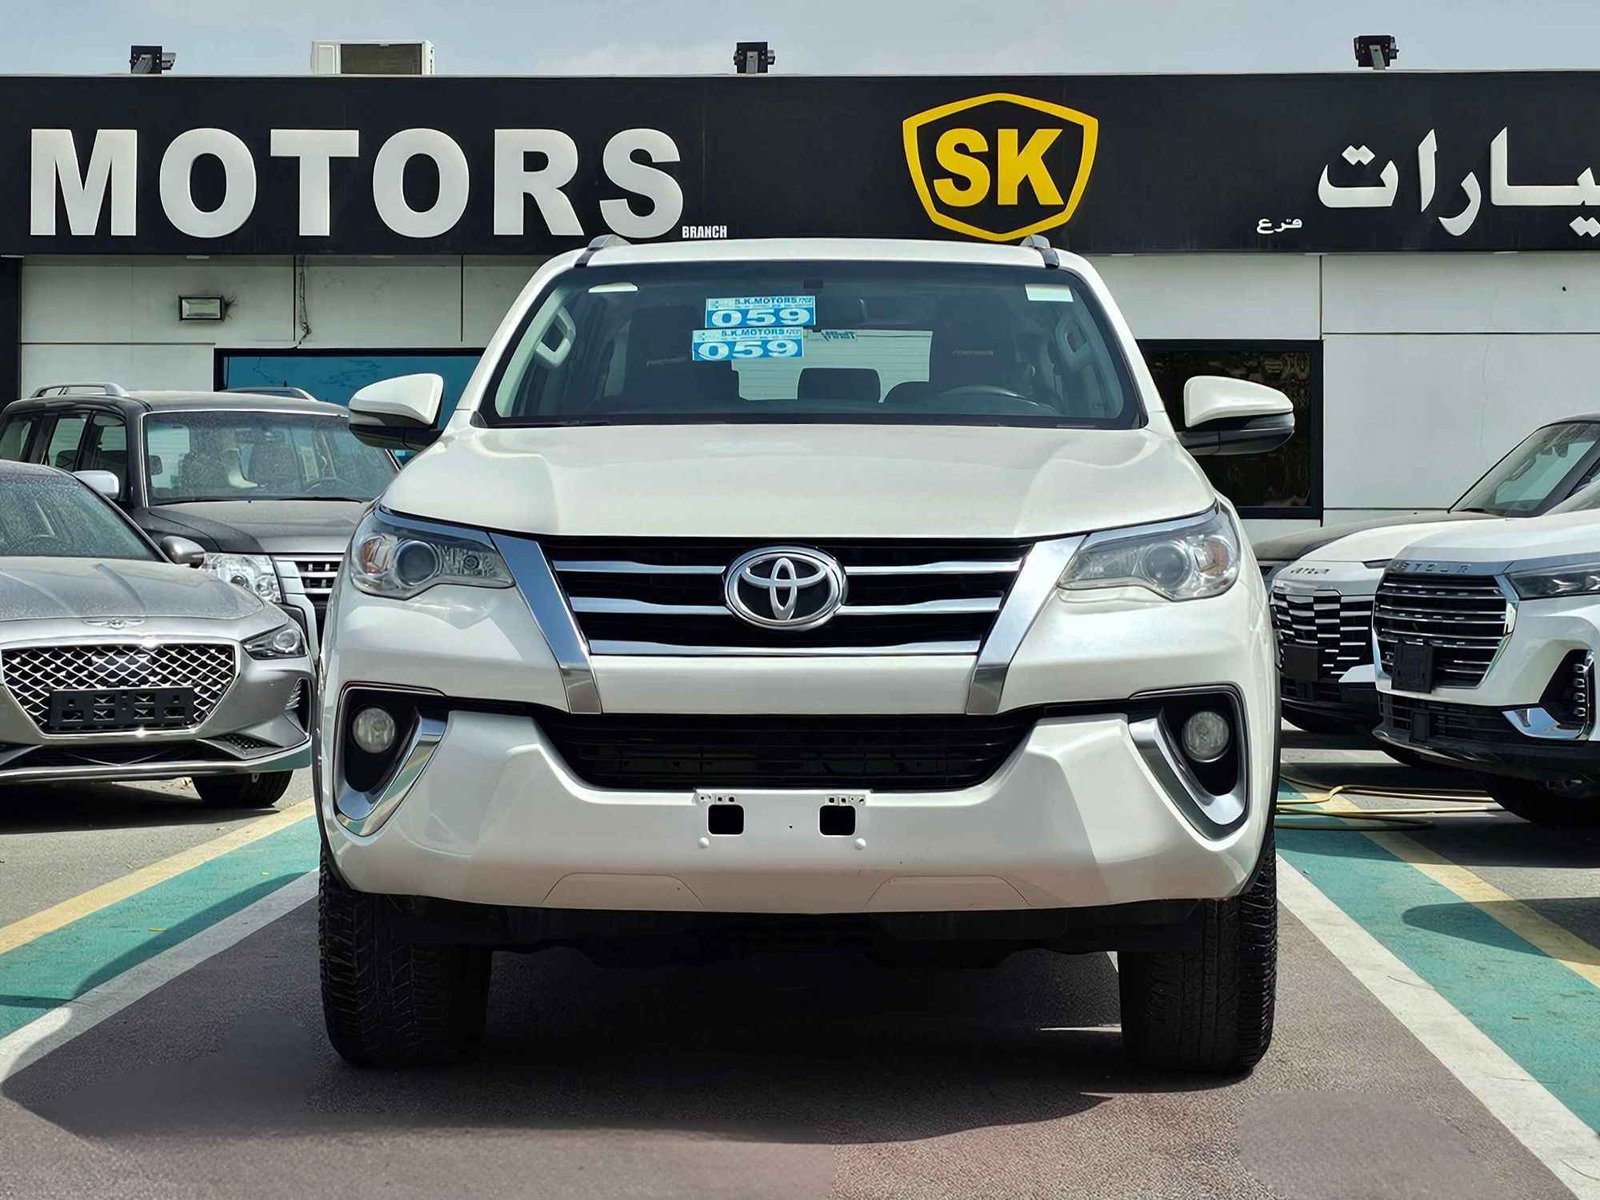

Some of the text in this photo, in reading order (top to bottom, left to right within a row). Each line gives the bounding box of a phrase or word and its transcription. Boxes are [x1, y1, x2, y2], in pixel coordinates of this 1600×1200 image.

[932, 127, 1065, 208] SK
[30, 127, 685, 239] MOTORS
[681, 225, 728, 239] BRANCH
[1256, 218, 1303, 234] فرع
[711, 308, 810, 326] 059
[698, 340, 798, 360] 059
